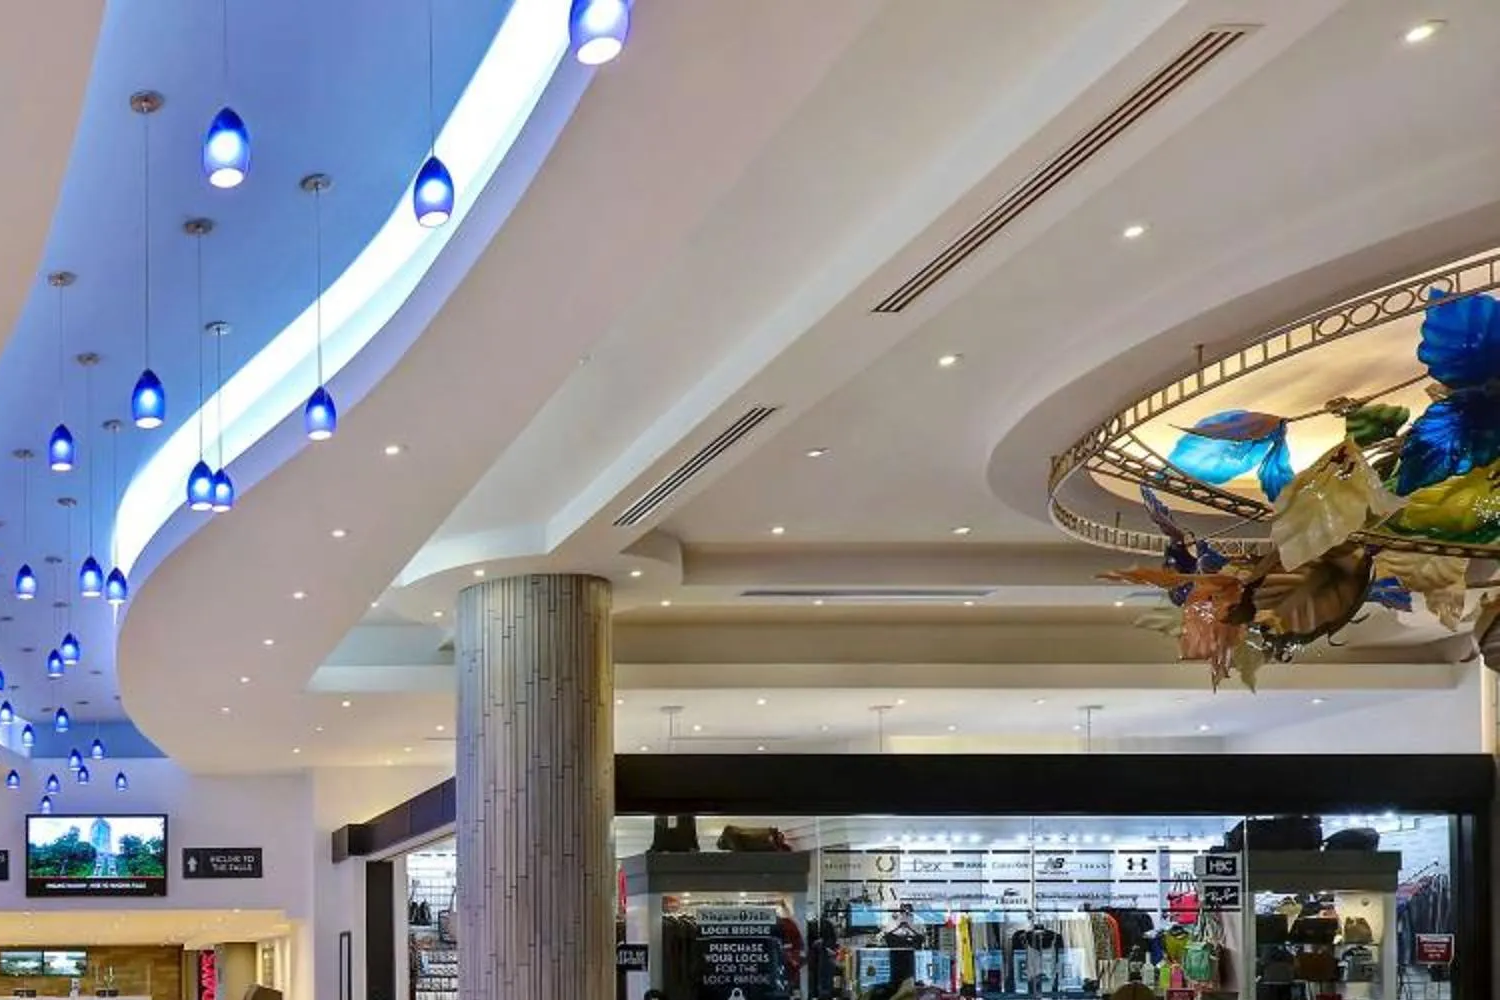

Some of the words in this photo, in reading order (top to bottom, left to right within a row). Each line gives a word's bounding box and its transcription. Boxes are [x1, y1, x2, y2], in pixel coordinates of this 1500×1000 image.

[701, 925, 730, 935] LOCK
[709, 943, 765, 952] PURCHASE
[704, 953, 734, 963] YOUR
[735, 953, 770, 963] LOCKS
[703, 974, 732, 985] LOCK
